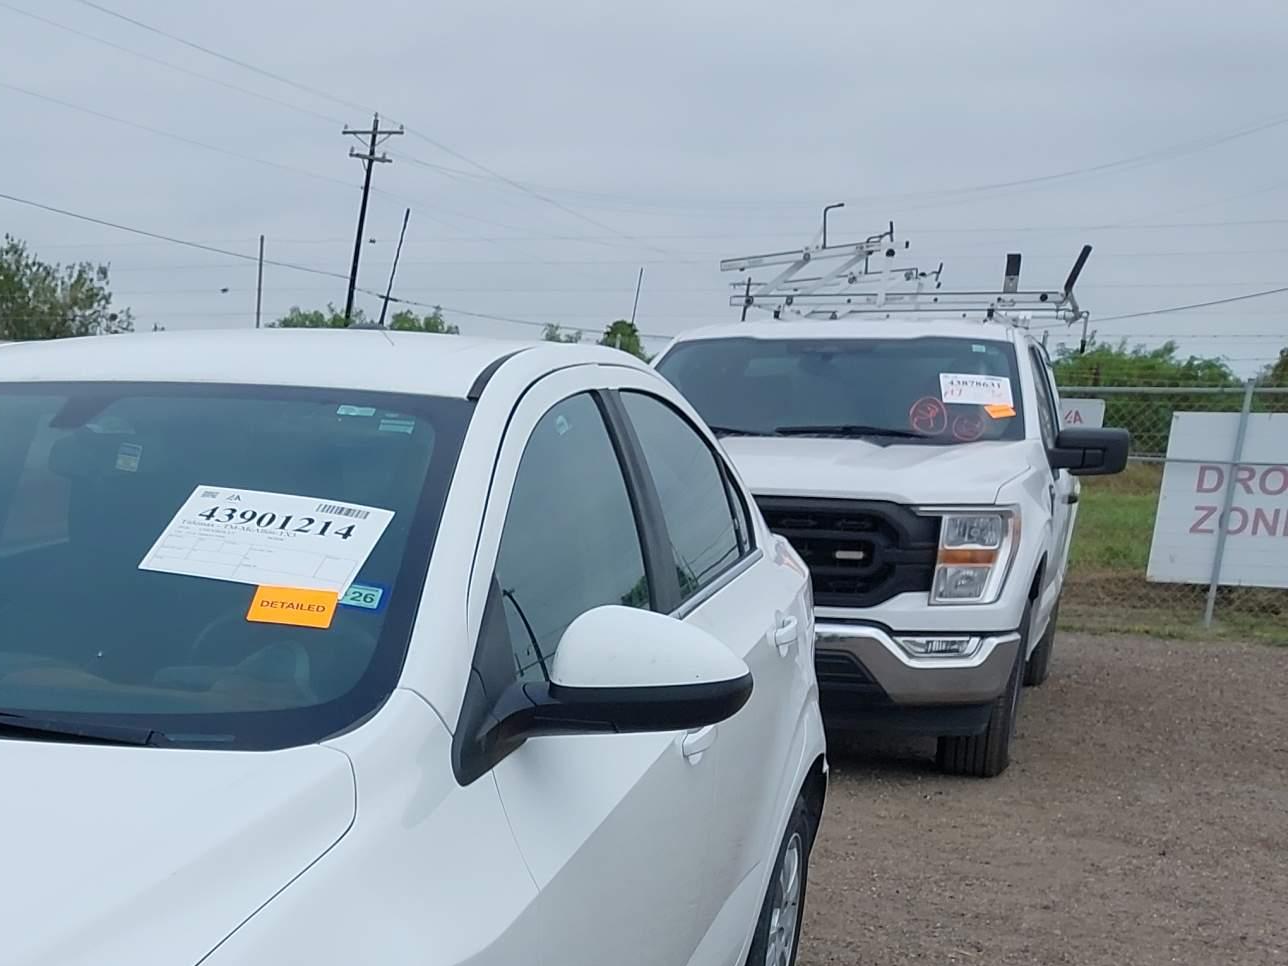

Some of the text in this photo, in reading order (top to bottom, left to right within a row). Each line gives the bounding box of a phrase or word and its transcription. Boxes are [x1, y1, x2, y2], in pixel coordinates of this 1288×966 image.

[197, 505, 357, 540] 43901214
[349, 591, 375, 604] 26
[259, 599, 326, 614] DETAILED
